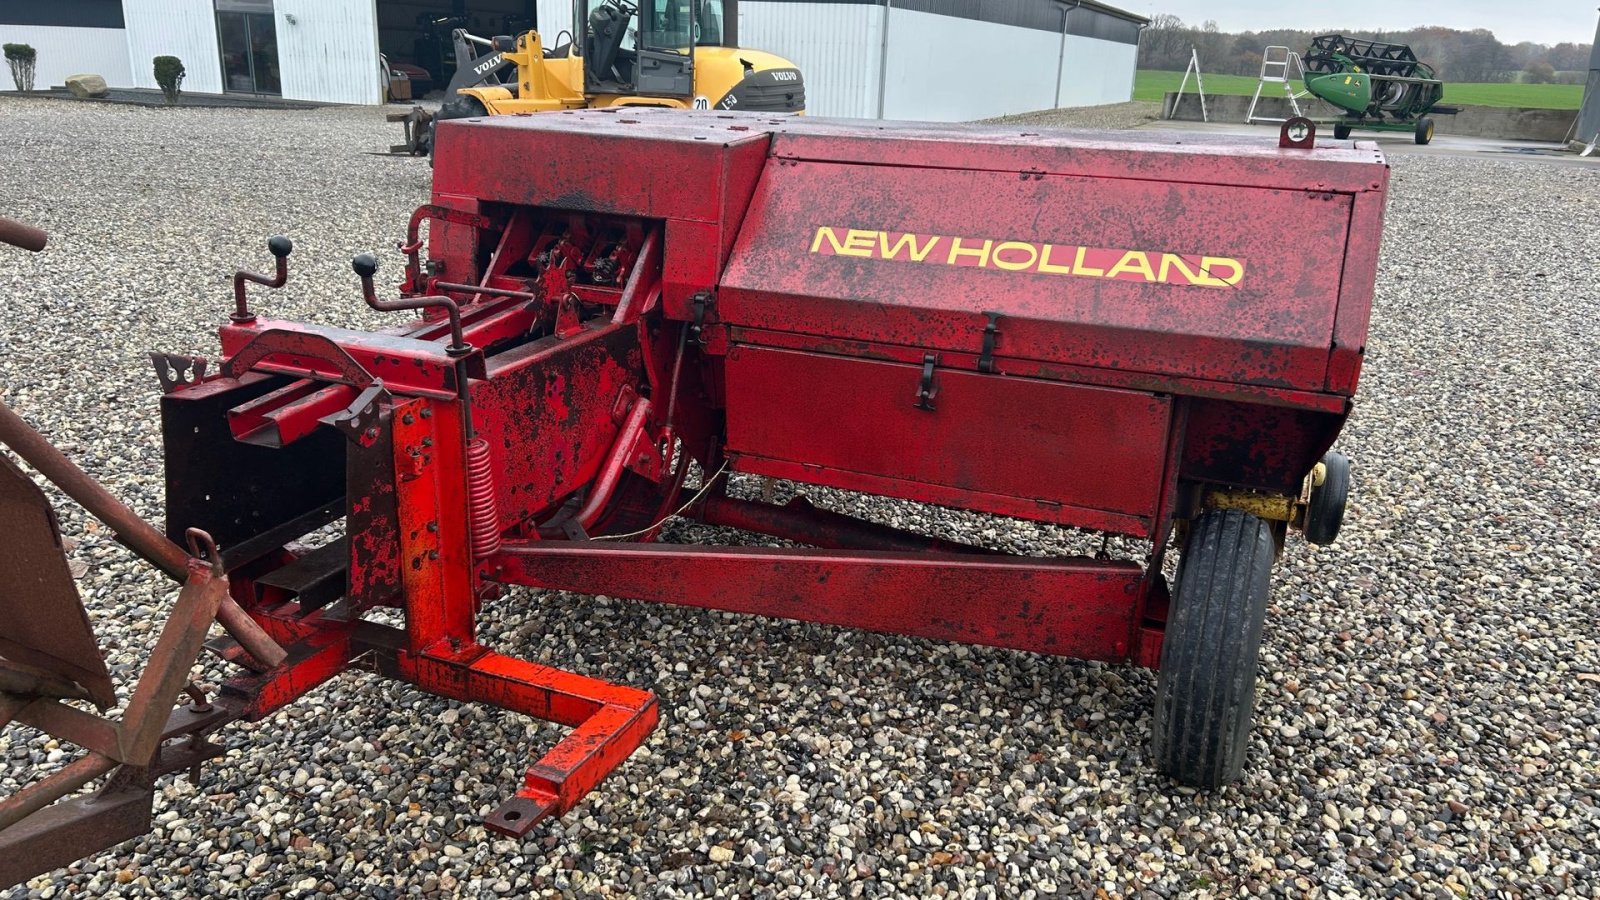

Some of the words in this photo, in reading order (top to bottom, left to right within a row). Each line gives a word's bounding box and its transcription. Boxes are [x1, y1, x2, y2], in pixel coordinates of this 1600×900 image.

[473, 53, 502, 75] VOLV
[771, 71, 797, 81] VOLVO
[695, 99, 707, 110] 20
[811, 226, 940, 262] NEW
[947, 237, 1244, 287] HOLLAND
